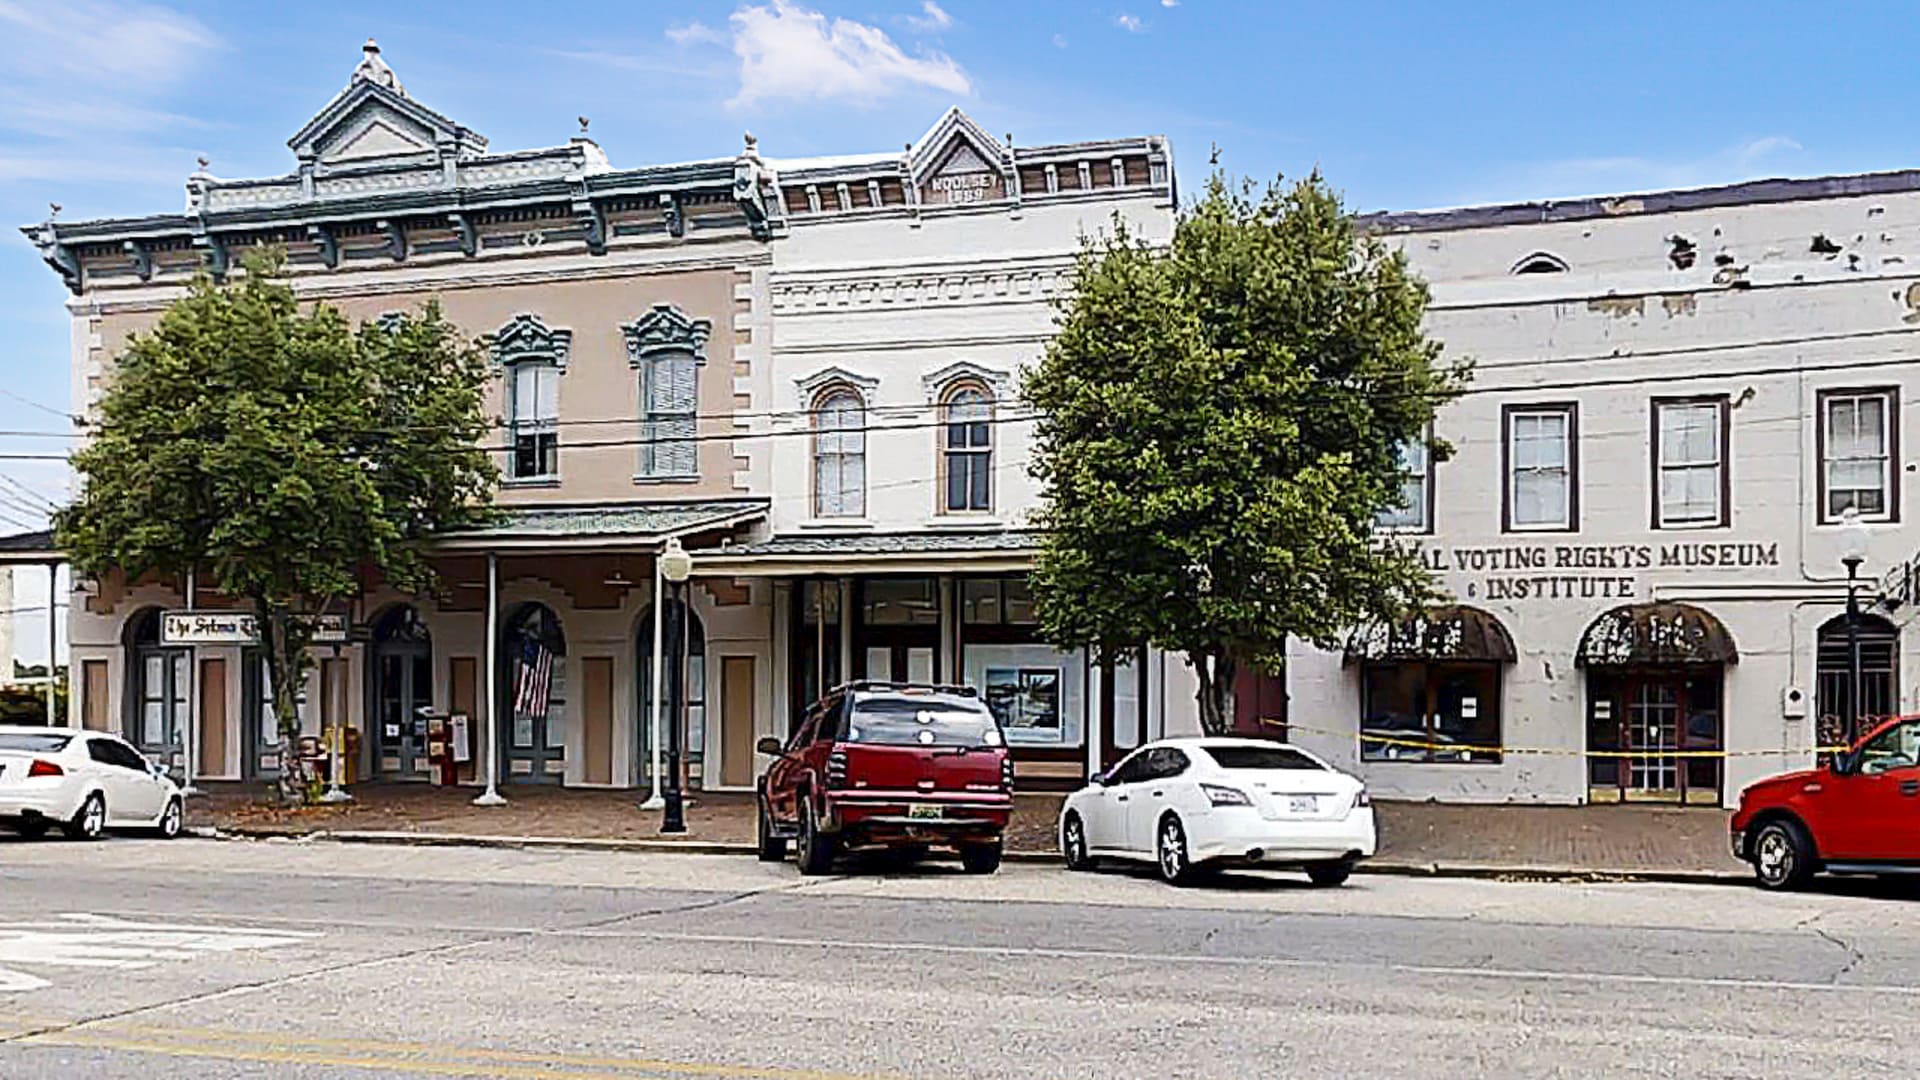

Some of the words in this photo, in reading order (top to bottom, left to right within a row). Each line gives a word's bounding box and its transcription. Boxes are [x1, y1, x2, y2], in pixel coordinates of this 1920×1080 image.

[1453, 547, 1546, 571] VOTING
[1555, 545, 1651, 569] RIGHTS
[1659, 542, 1779, 567] MUSEUM
[1486, 576, 1635, 600] INSTITUTE
